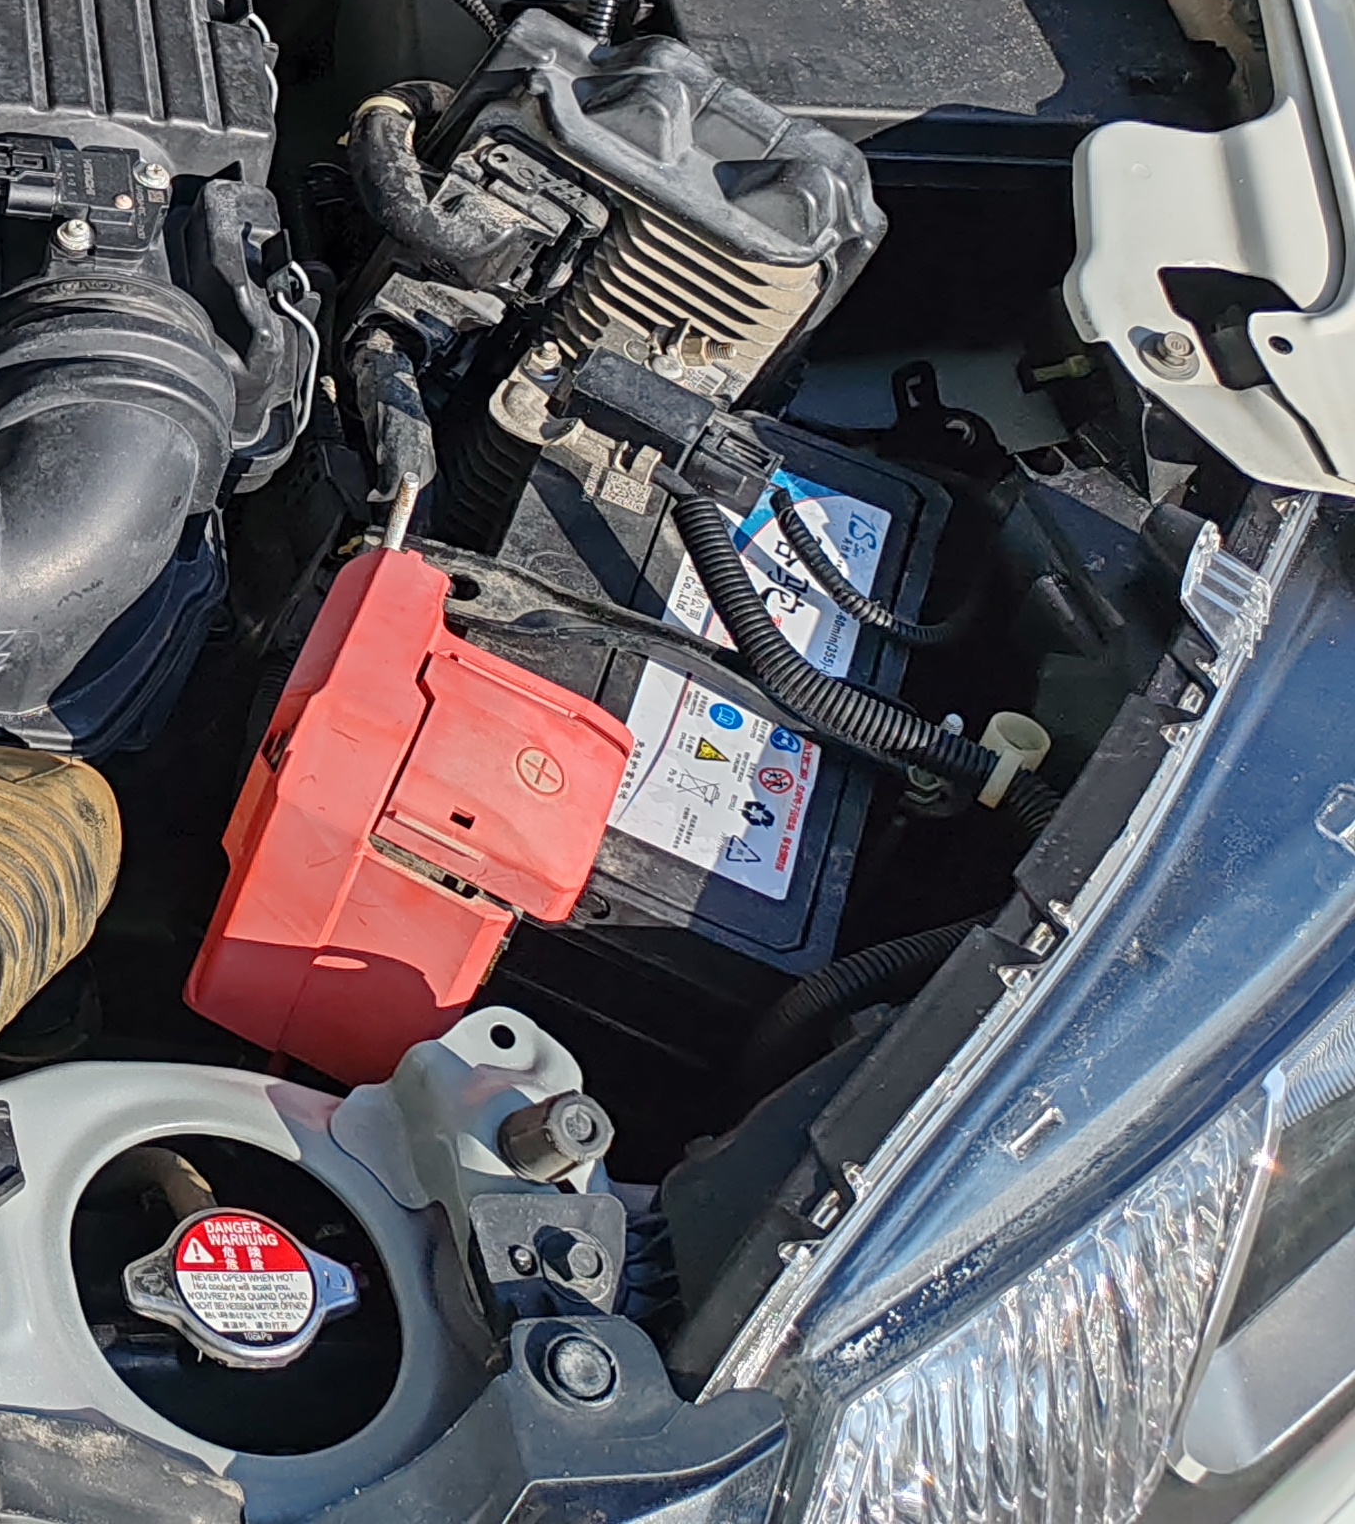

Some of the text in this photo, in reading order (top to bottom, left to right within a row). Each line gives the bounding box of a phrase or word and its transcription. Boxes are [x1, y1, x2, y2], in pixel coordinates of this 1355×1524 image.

[82, 158, 96, 196] HITACHI
[203, 1221, 262, 1234] DANGER
[207, 1233, 279, 1246] WARNUNG
[191, 1273, 298, 1282] NEVER OPEN WHEN HOT.
[193, 1282, 207, 1291] Hot
[208, 1283, 236, 1291] coolant
[237, 1283, 250, 1291] will
[274, 1284, 291, 1292] you.
[230, 1292, 246, 1301] PAS
[247, 1292, 277, 1301] QUAND
[193, 1301, 213, 1310] NICHT
[214, 1302, 225, 1310] BEI
[255, 1302, 279, 1310] MOTOR
